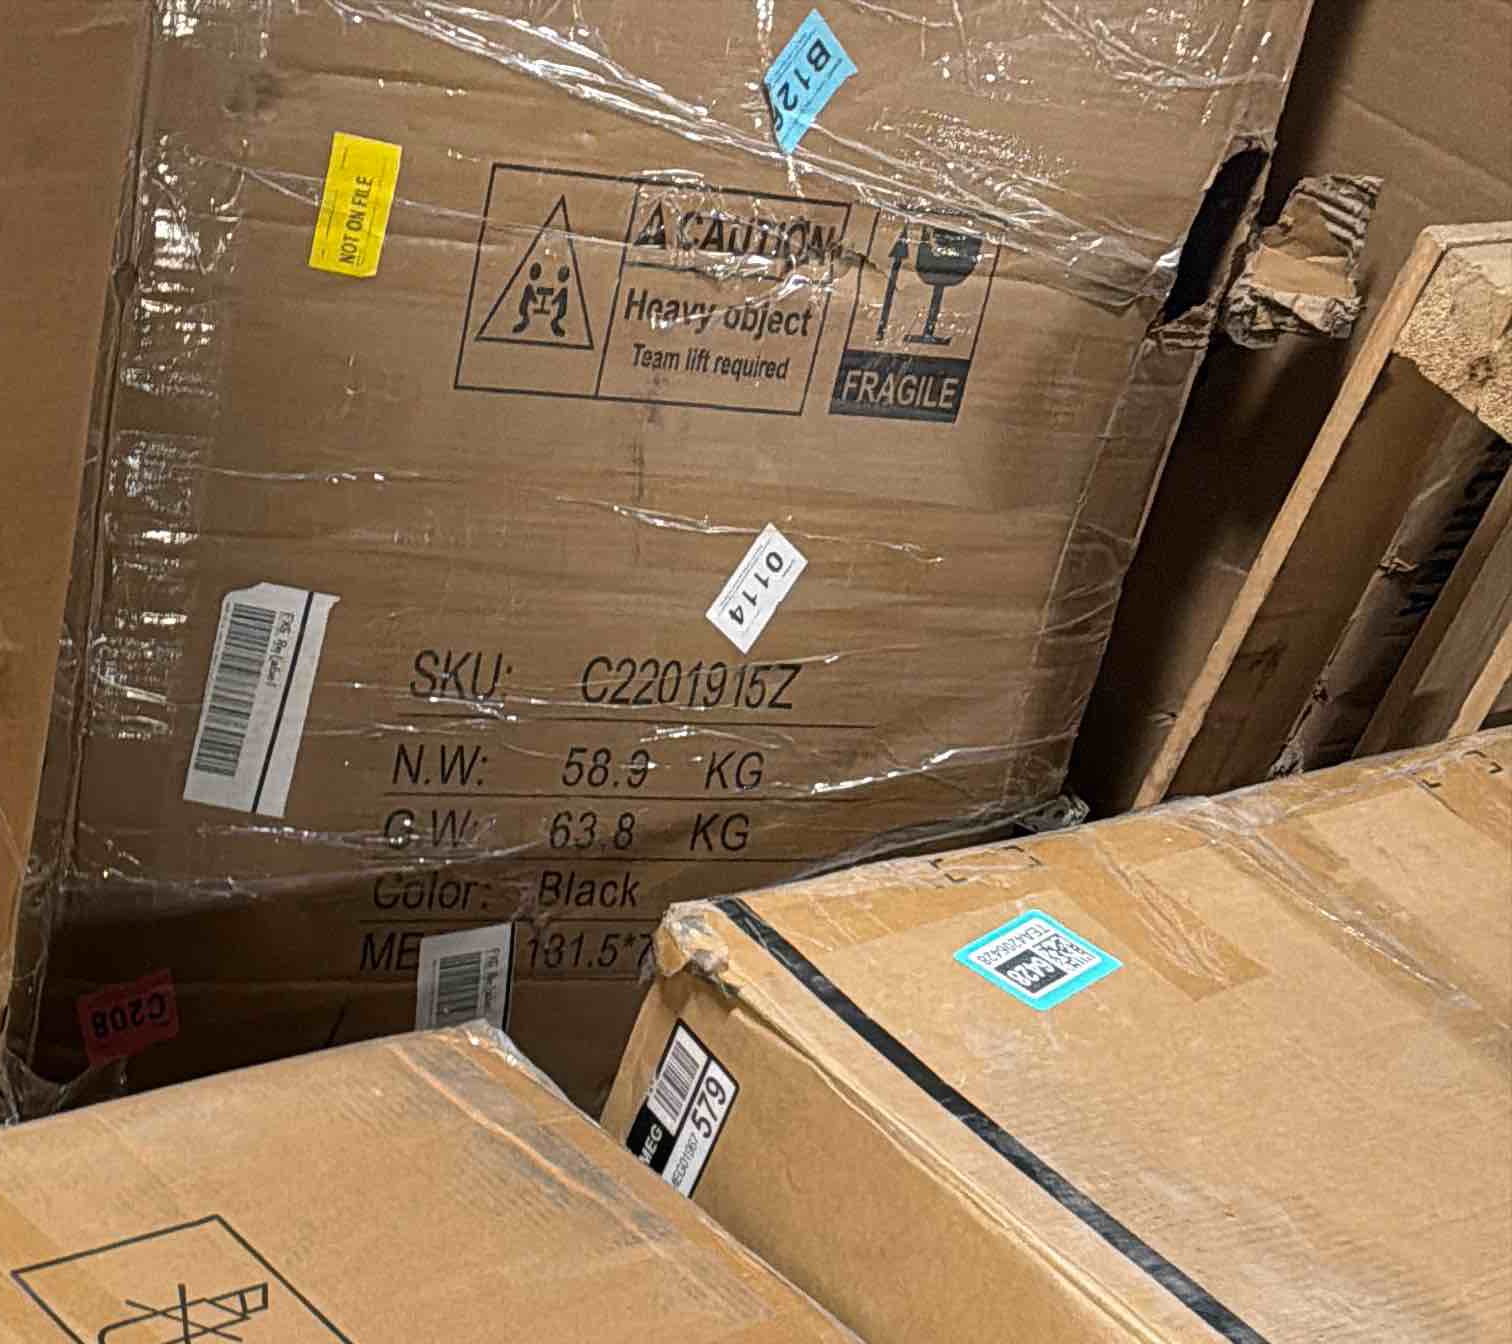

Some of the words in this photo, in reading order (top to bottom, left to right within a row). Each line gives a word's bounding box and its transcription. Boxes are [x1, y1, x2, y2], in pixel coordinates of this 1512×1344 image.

[345, 205, 365, 233] ON
[676, 210, 840, 262] CAUTION
[338, 233, 359, 265] NOT
[623, 288, 716, 334] Heavy
[722, 303, 815, 339] object
[631, 343, 682, 372] Team
[685, 347, 711, 375] lift
[714, 352, 790, 382] required
[842, 370, 959, 411] FRAGILE
[728, 550, 784, 627] 0114
[409, 650, 513, 702] SKU:
[580, 657, 802, 710] C2201915Z
[392, 744, 488, 786] N.W:
[560, 747, 650, 789] 58.9
[704, 750, 765, 791] KG
[549, 811, 637, 852] 63.8
[689, 814, 751, 853] KG
[373, 871, 490, 911] Color:
[538, 870, 640, 908] Black
[1007, 955, 1056, 987] 6428
[691, 1076, 727, 1139] 579
